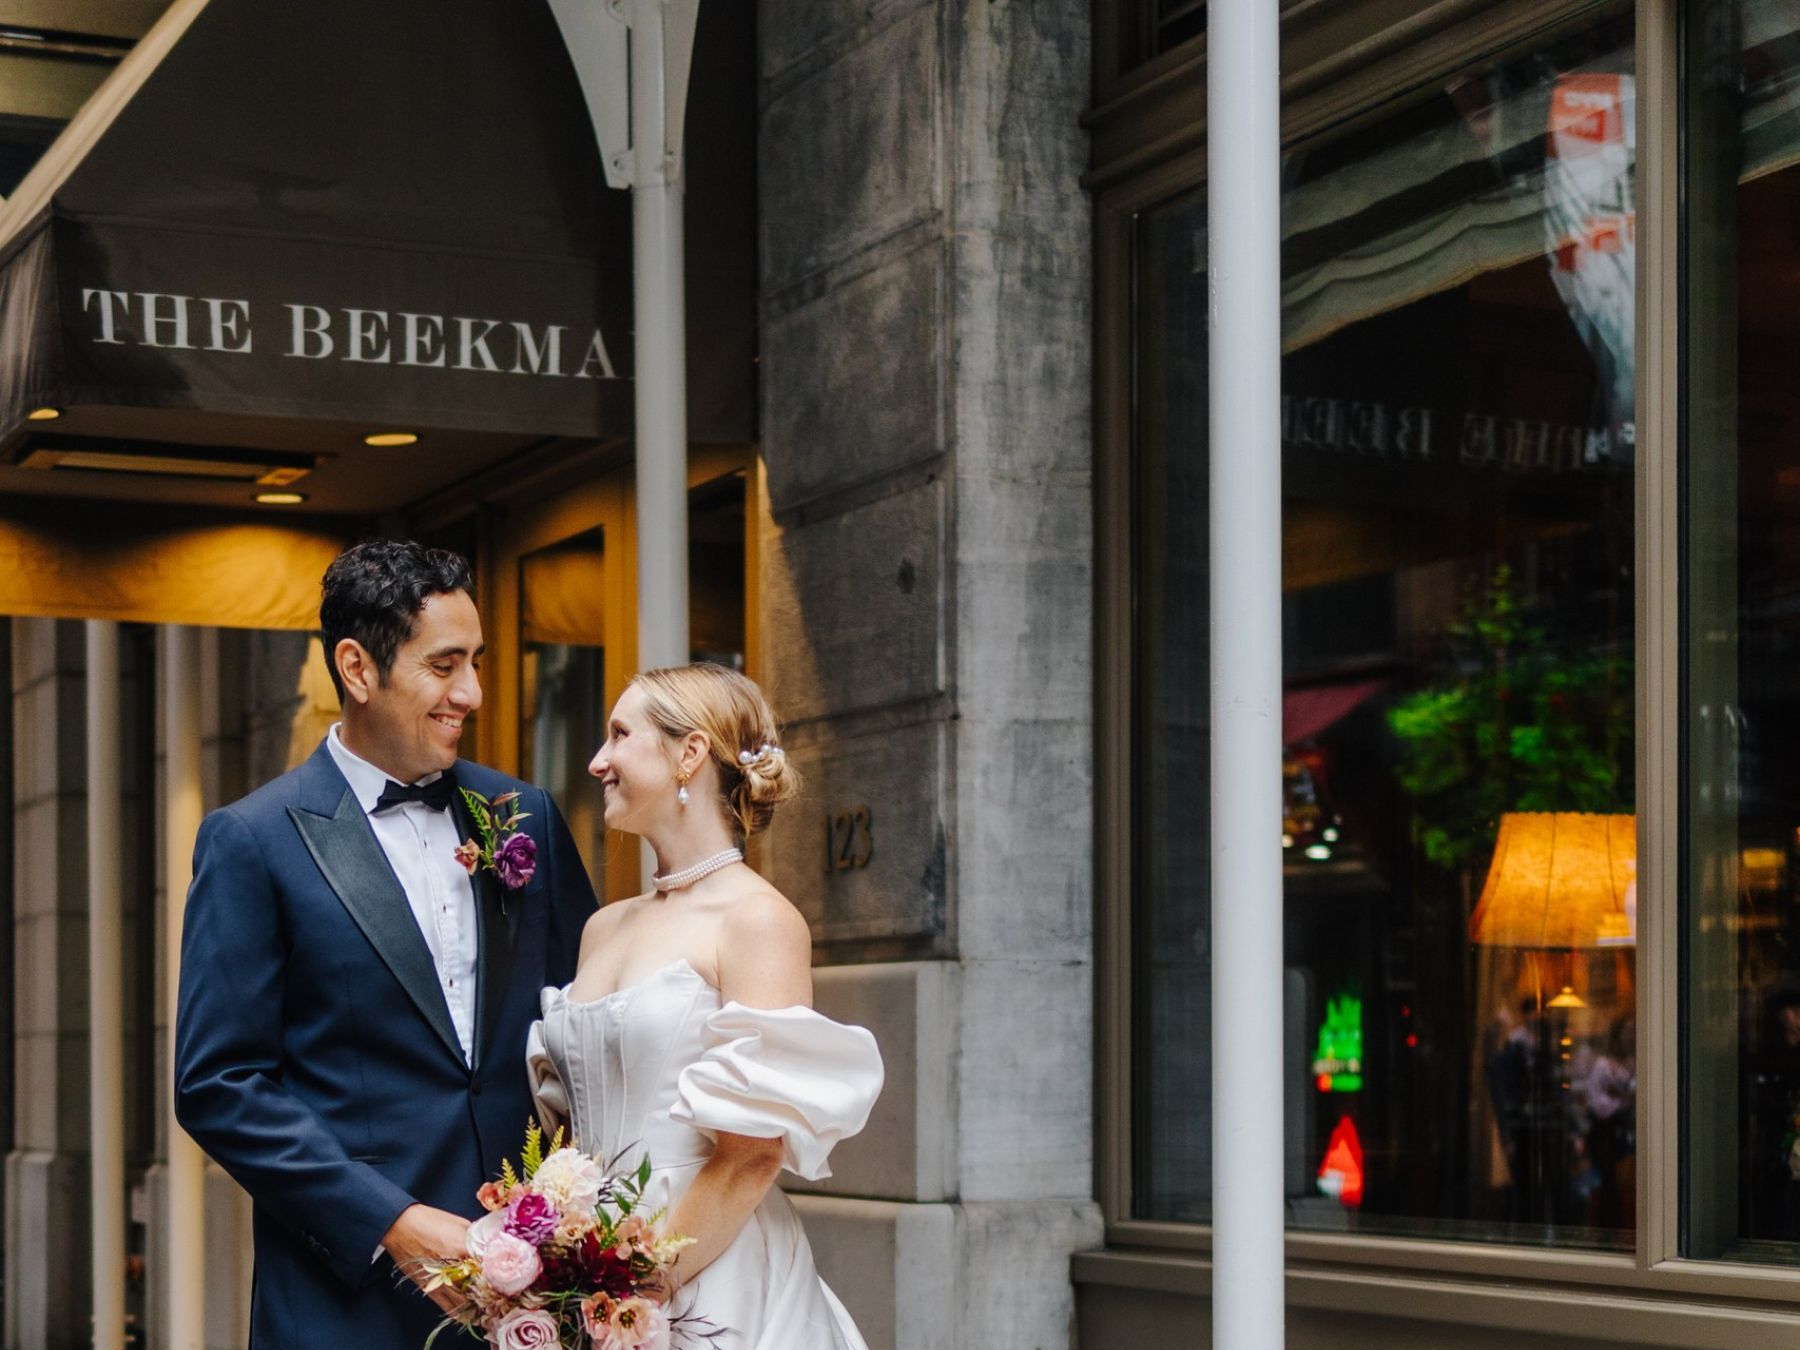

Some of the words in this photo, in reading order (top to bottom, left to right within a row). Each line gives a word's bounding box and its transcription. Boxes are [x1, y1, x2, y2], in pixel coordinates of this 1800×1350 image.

[82, 288, 253, 354] THE
[283, 304, 635, 380] BEEKMA
[826, 803, 874, 873] 123
